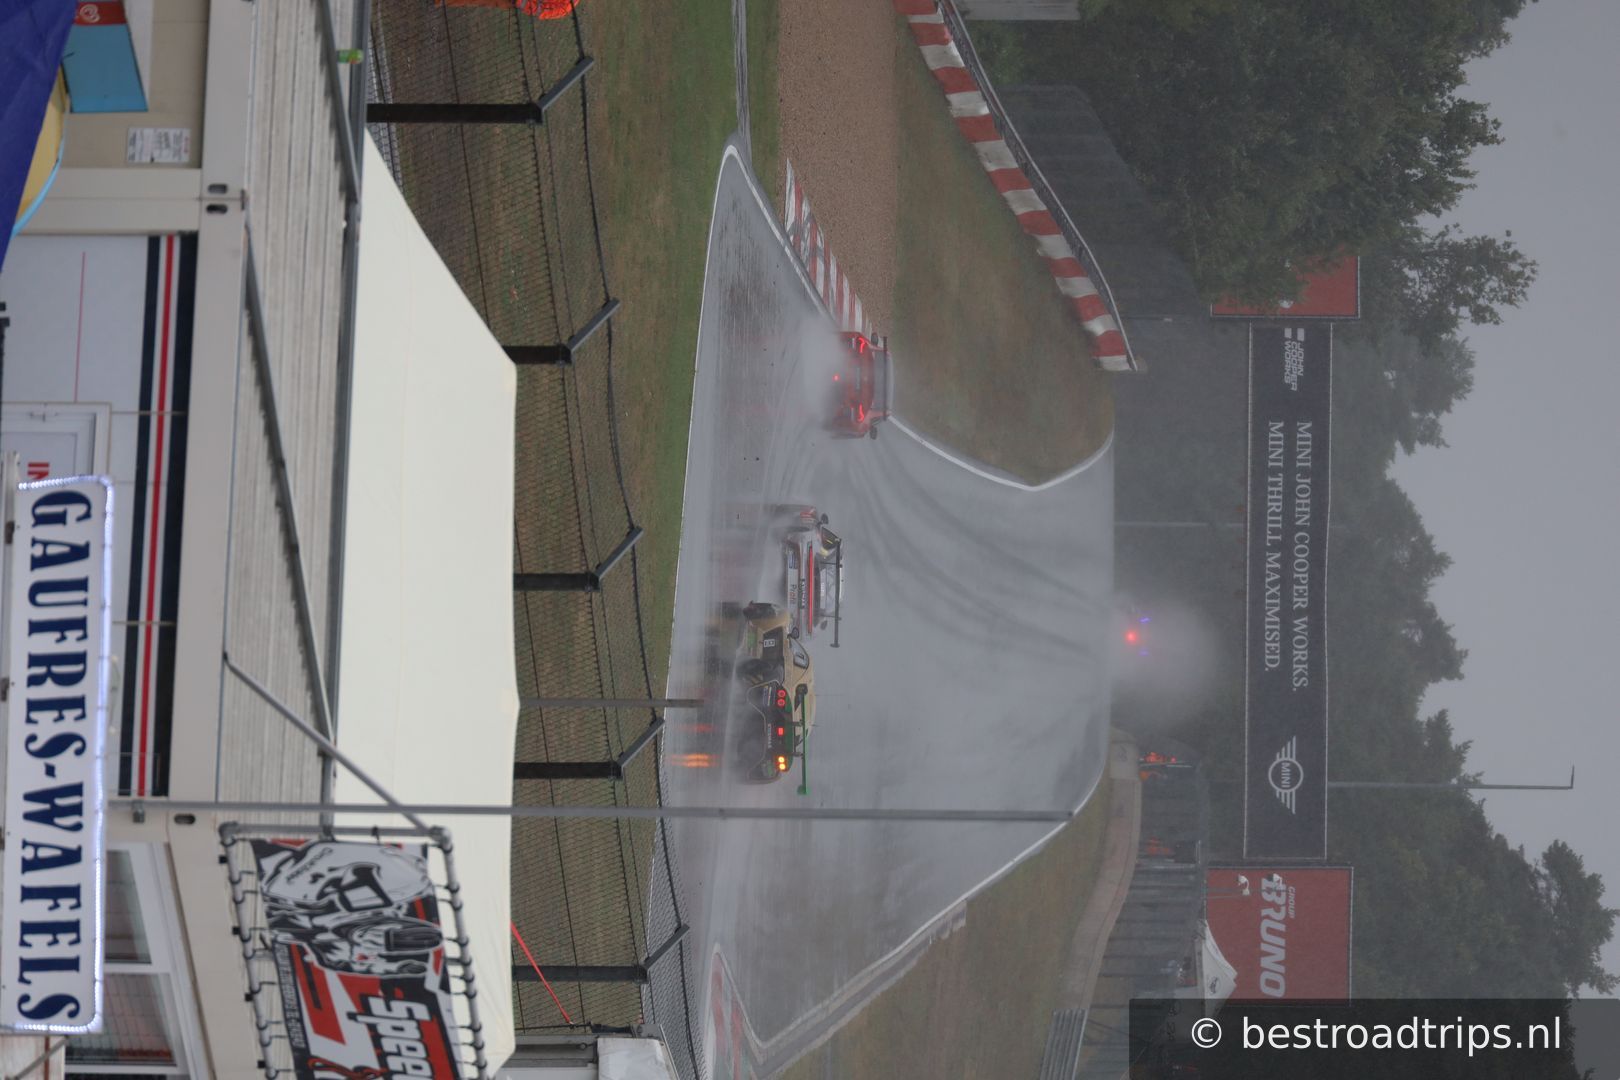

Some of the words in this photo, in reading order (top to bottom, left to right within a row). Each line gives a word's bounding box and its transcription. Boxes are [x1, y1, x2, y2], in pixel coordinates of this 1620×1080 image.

[1267, 421, 1284, 468] MINI
[1295, 421, 1313, 468] MINI
[1265, 472, 1284, 547] THRILL
[1294, 473, 1312, 526] JOHN
[1292, 531, 1310, 609] COOPER
[1263, 551, 1281, 672] MAXIMISED.
[1292, 615, 1309, 692] WORKS.
[17, 489, 93, 1021] GAUFRES-WAFELS
[1281, 762, 1291, 788] MINI
[1259, 877, 1287, 998] BRUNO
[1287, 886, 1296, 919] GROUP
